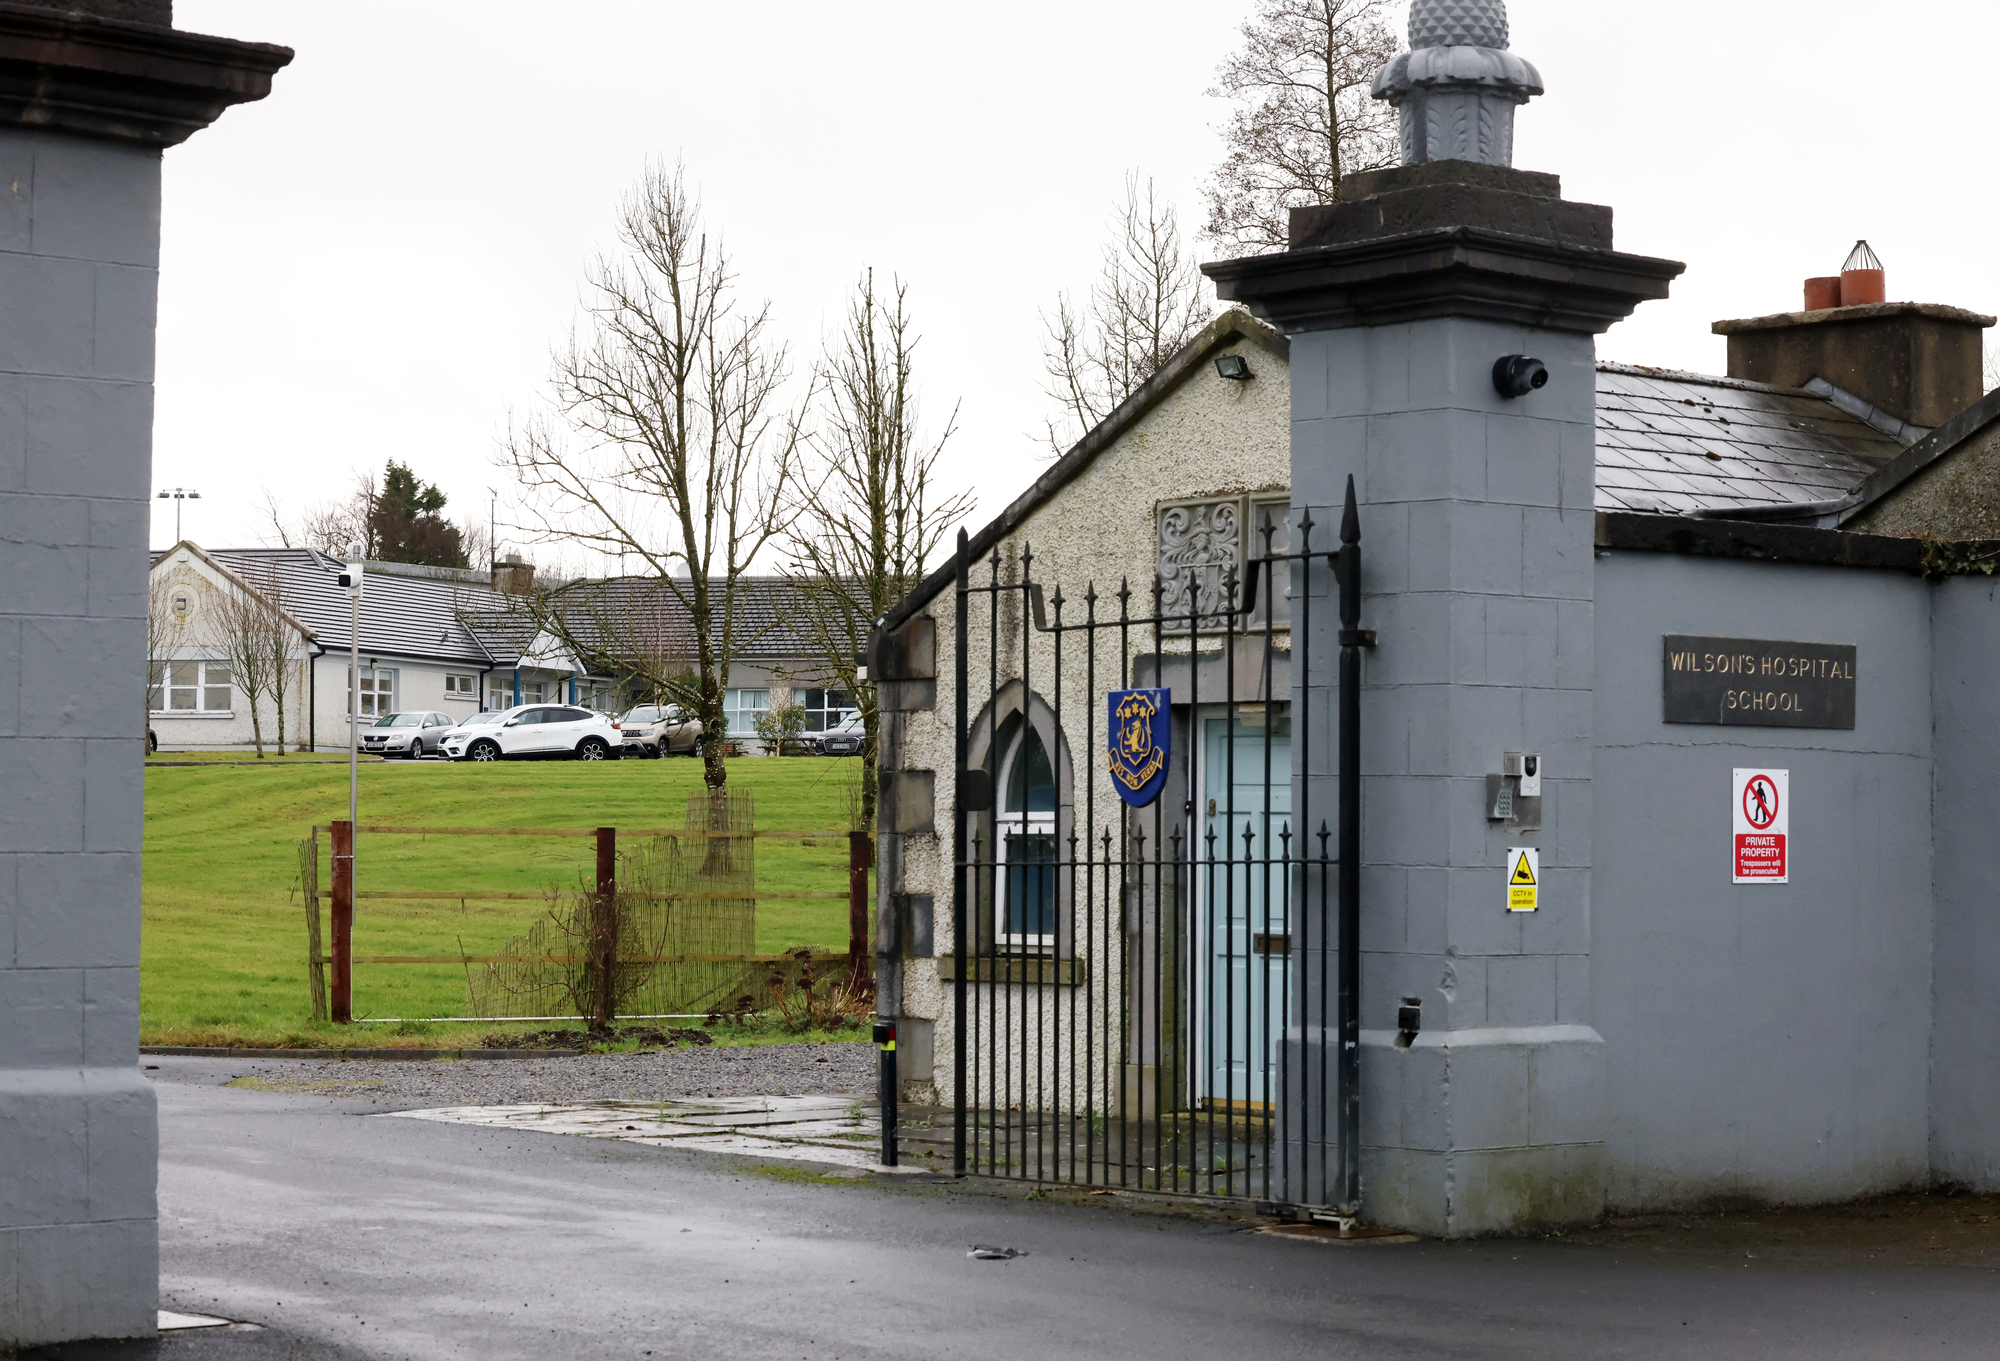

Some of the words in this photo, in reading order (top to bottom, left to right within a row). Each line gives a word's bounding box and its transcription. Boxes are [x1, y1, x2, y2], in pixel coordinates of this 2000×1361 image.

[1671, 652, 1755, 675] WILSON'S
[1762, 657, 1853, 679] HOSPITAL
[1727, 690, 1803, 712] SCHOOL
[1745, 836, 1776, 846] PRIVATE
[1740, 847, 1780, 857] PROPERTY
[1740, 859, 1771, 868] Trespassers
[1772, 859, 1781, 867] will
[1750, 868, 1778, 876] prosecuted
